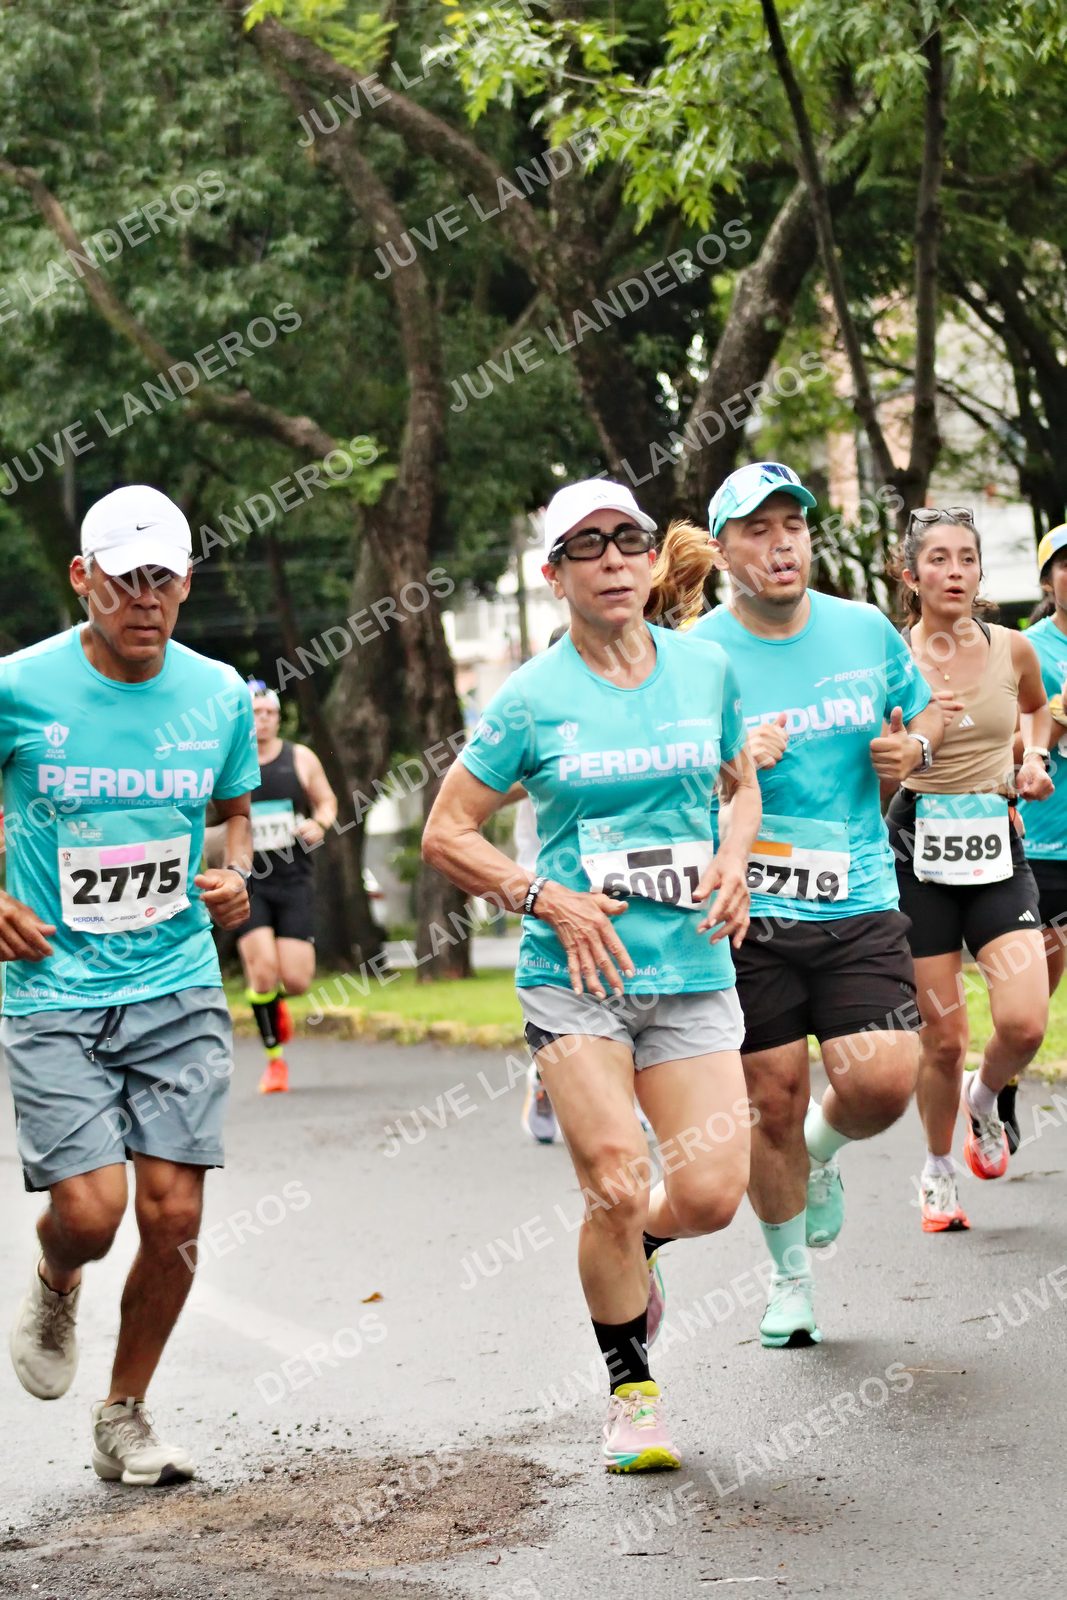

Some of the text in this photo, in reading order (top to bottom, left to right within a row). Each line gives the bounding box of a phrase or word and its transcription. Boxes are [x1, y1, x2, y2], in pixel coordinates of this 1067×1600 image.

[833, 668, 873, 683] BROOKS
[743, 695, 876, 735] EDURA
[177, 739, 220, 752] BROOKS
[559, 740, 719, 782] PERDURA
[38, 764, 214, 800] PERDURA
[921, 834, 1002, 862] 5589
[70, 857, 182, 905] 2775
[602, 866, 701, 906] 6001
[746, 861, 840, 903] 6719
